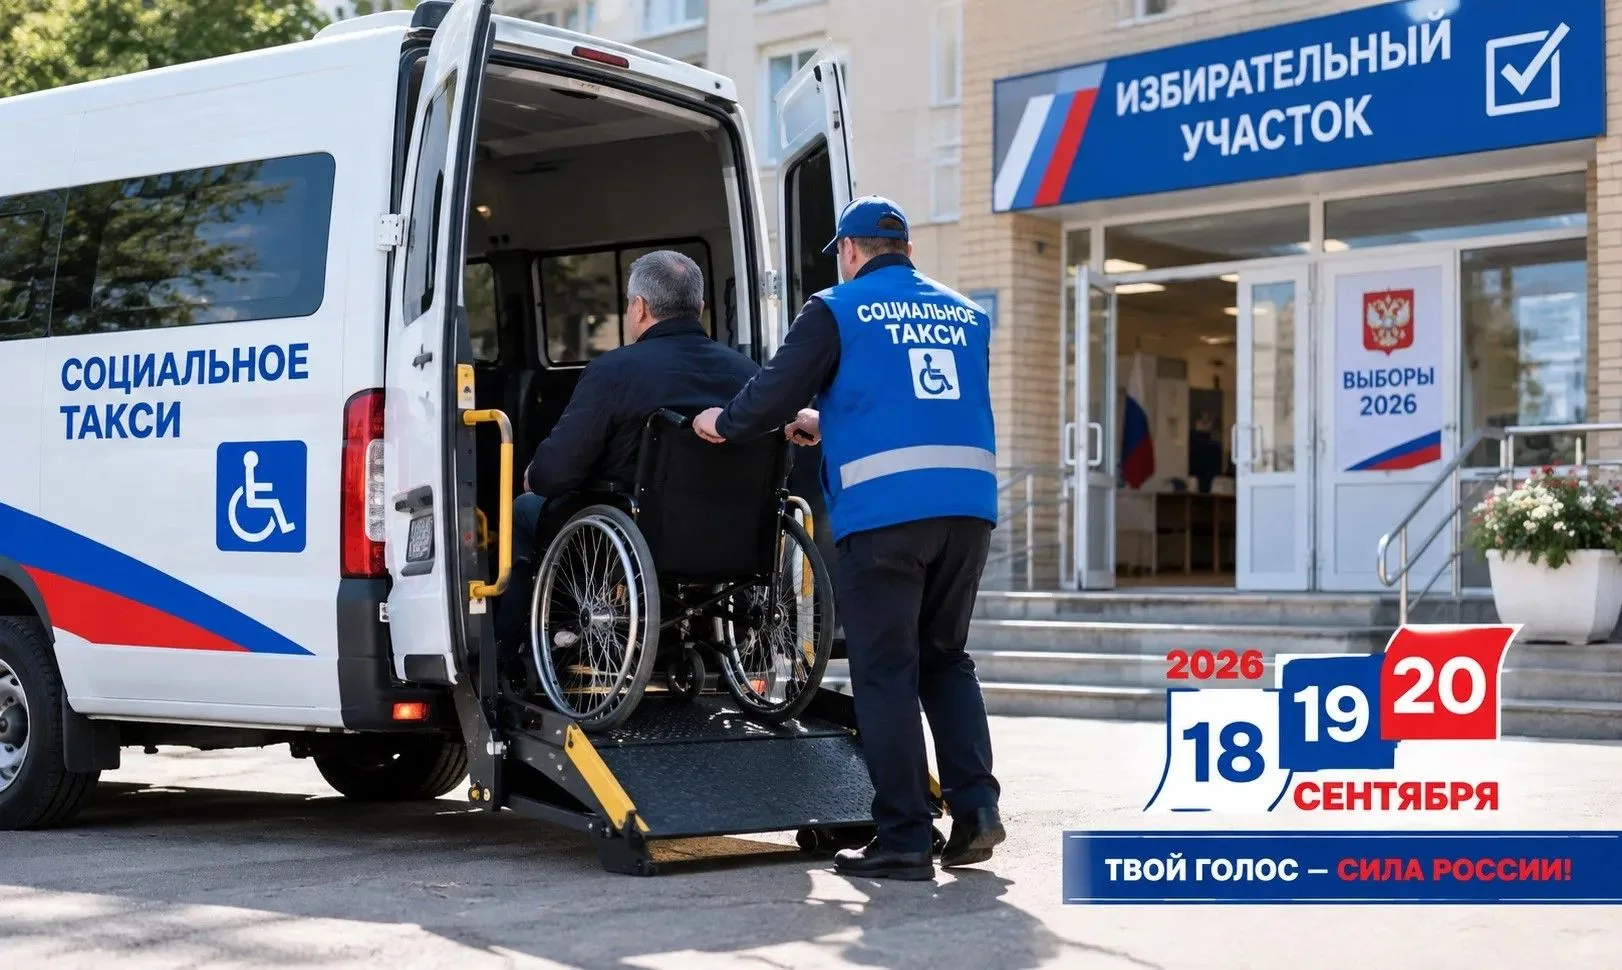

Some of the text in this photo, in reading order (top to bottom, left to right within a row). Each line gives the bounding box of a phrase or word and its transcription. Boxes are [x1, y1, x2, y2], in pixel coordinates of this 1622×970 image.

[1116, 9, 1452, 116] ИЗБИРАТЕЛЬНЫЙ
[1180, 94, 1373, 162] УЧАСТОК
[857, 301, 978, 326] СОЦИАЛЬНОЕ
[885, 323, 968, 347] ТАКСИ
[61, 342, 309, 395] СОЦИАЛЬНОЕ
[1343, 367, 1434, 390] ВЫБОРЫ
[60, 401, 181, 440] ТАКСИ
[1360, 394, 1417, 416] 2026
